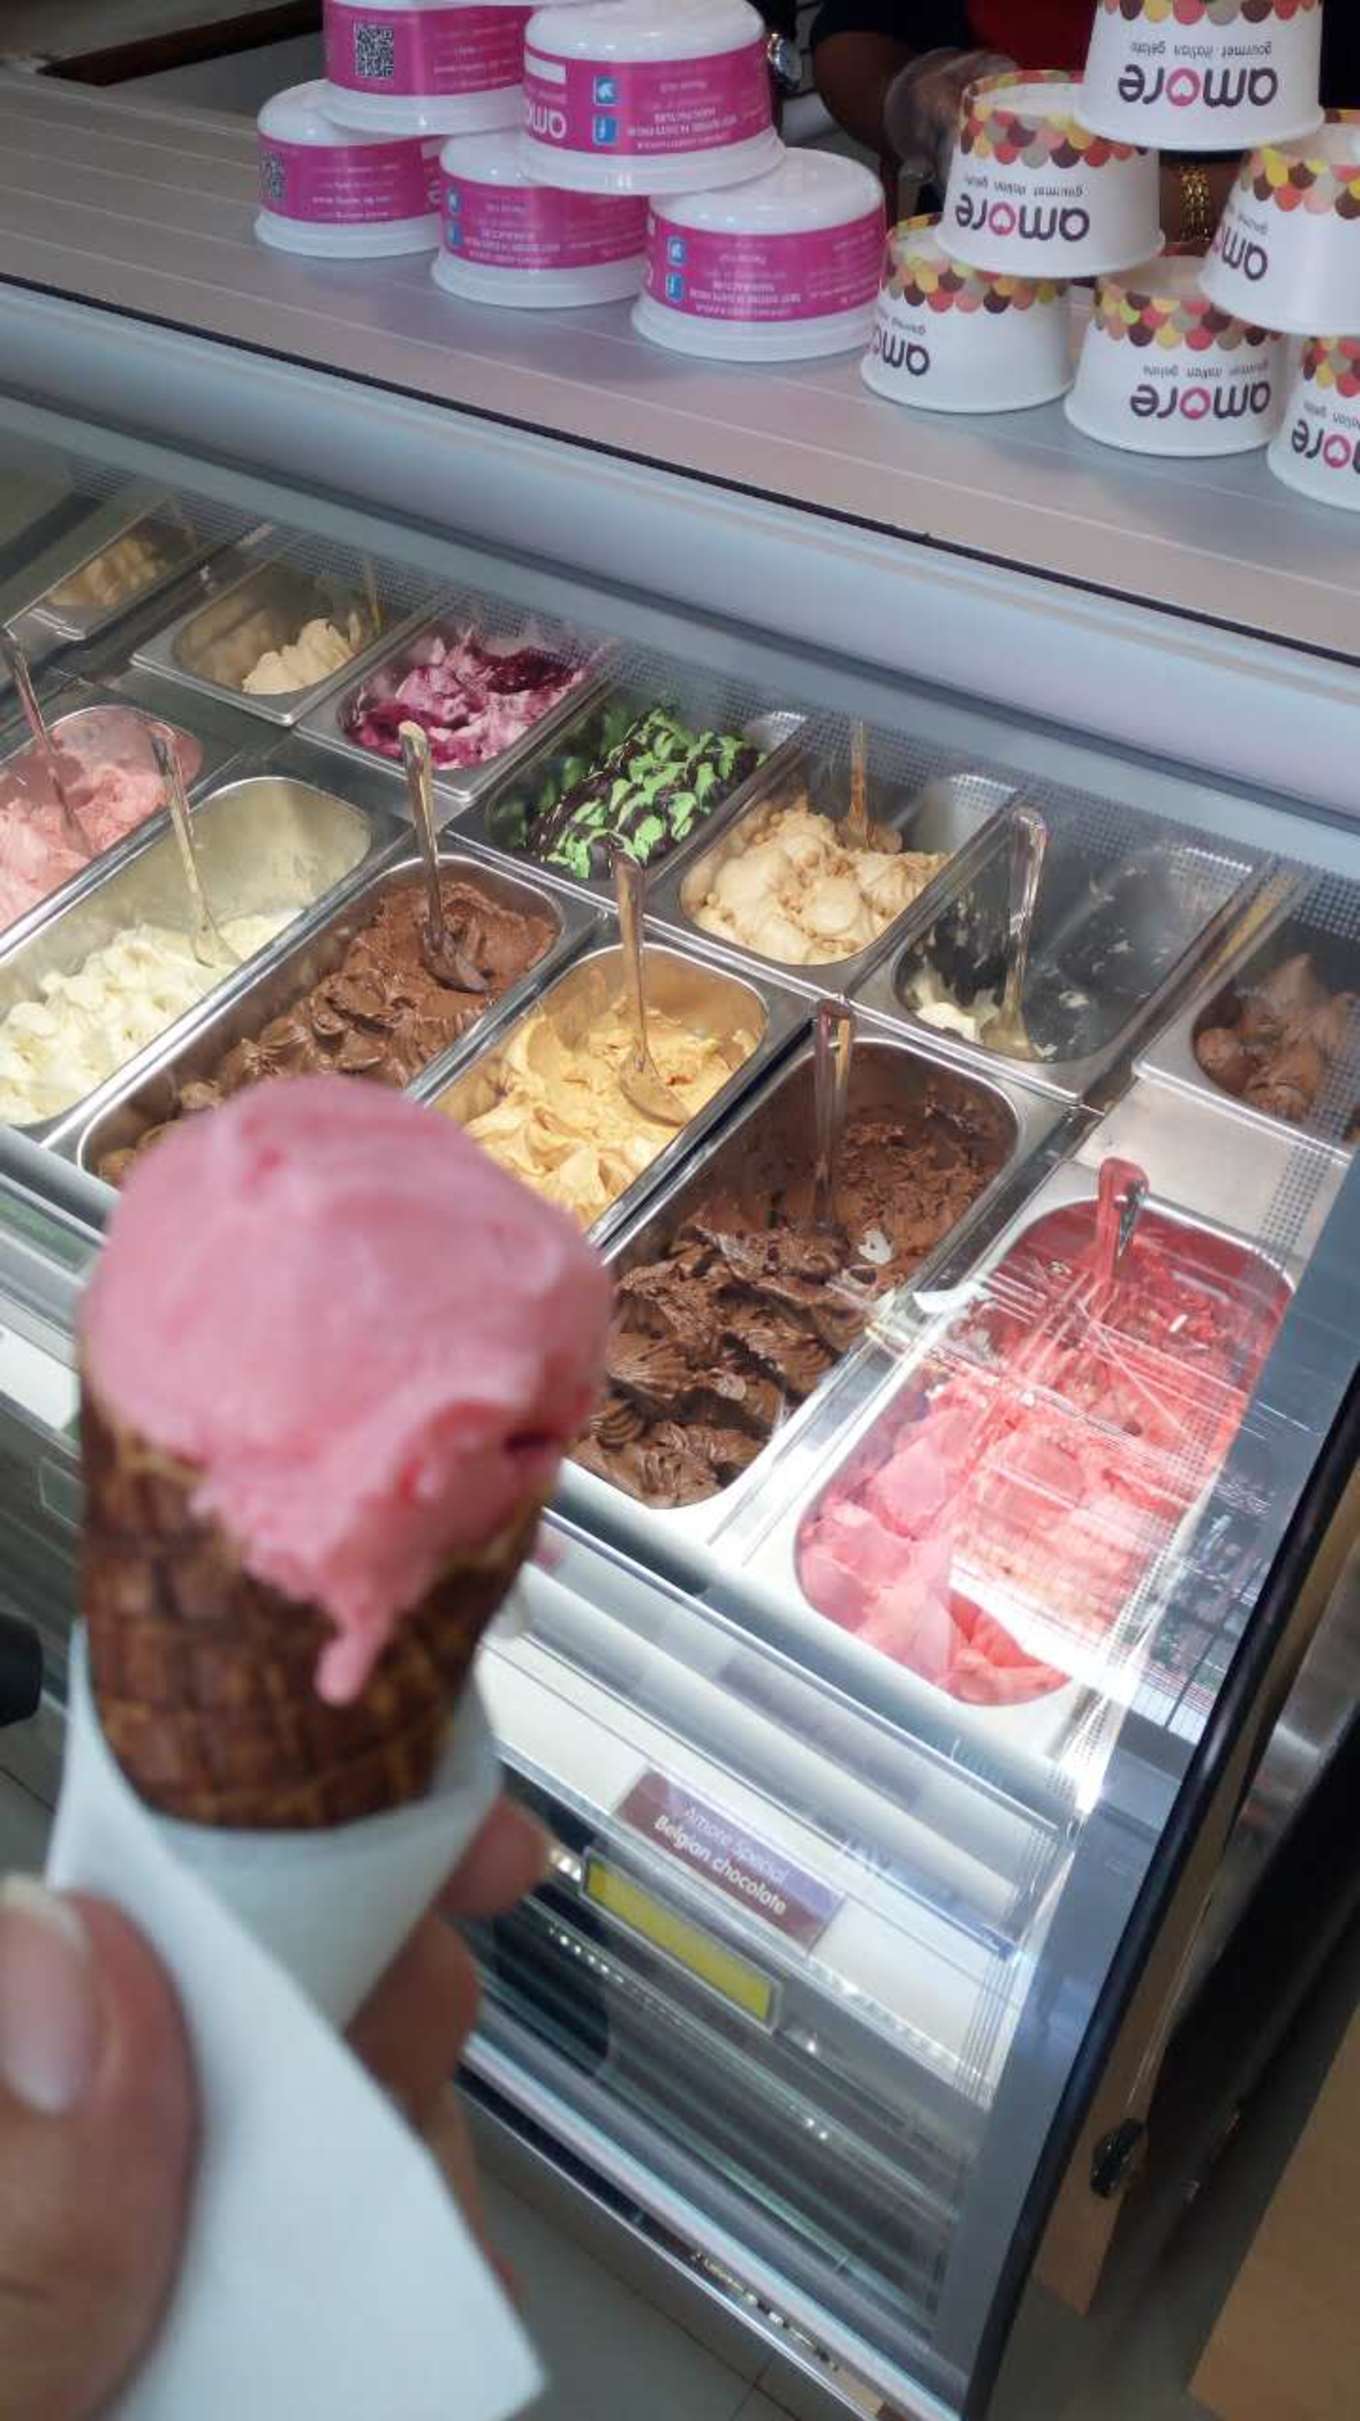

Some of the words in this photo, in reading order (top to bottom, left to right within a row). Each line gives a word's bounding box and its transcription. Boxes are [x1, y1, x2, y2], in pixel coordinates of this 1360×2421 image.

[1221, 42, 1273, 58] gourmet
[1118, 64, 1278, 108] amore
[955, 194, 1091, 243] amore
[1129, 381, 1271, 421] amore
[1290, 419, 1360, 475] ore
[686, 1806, 733, 1845] Amore
[654, 1814, 712, 1862] Belgian
[712, 1856, 787, 1915] chocolate
